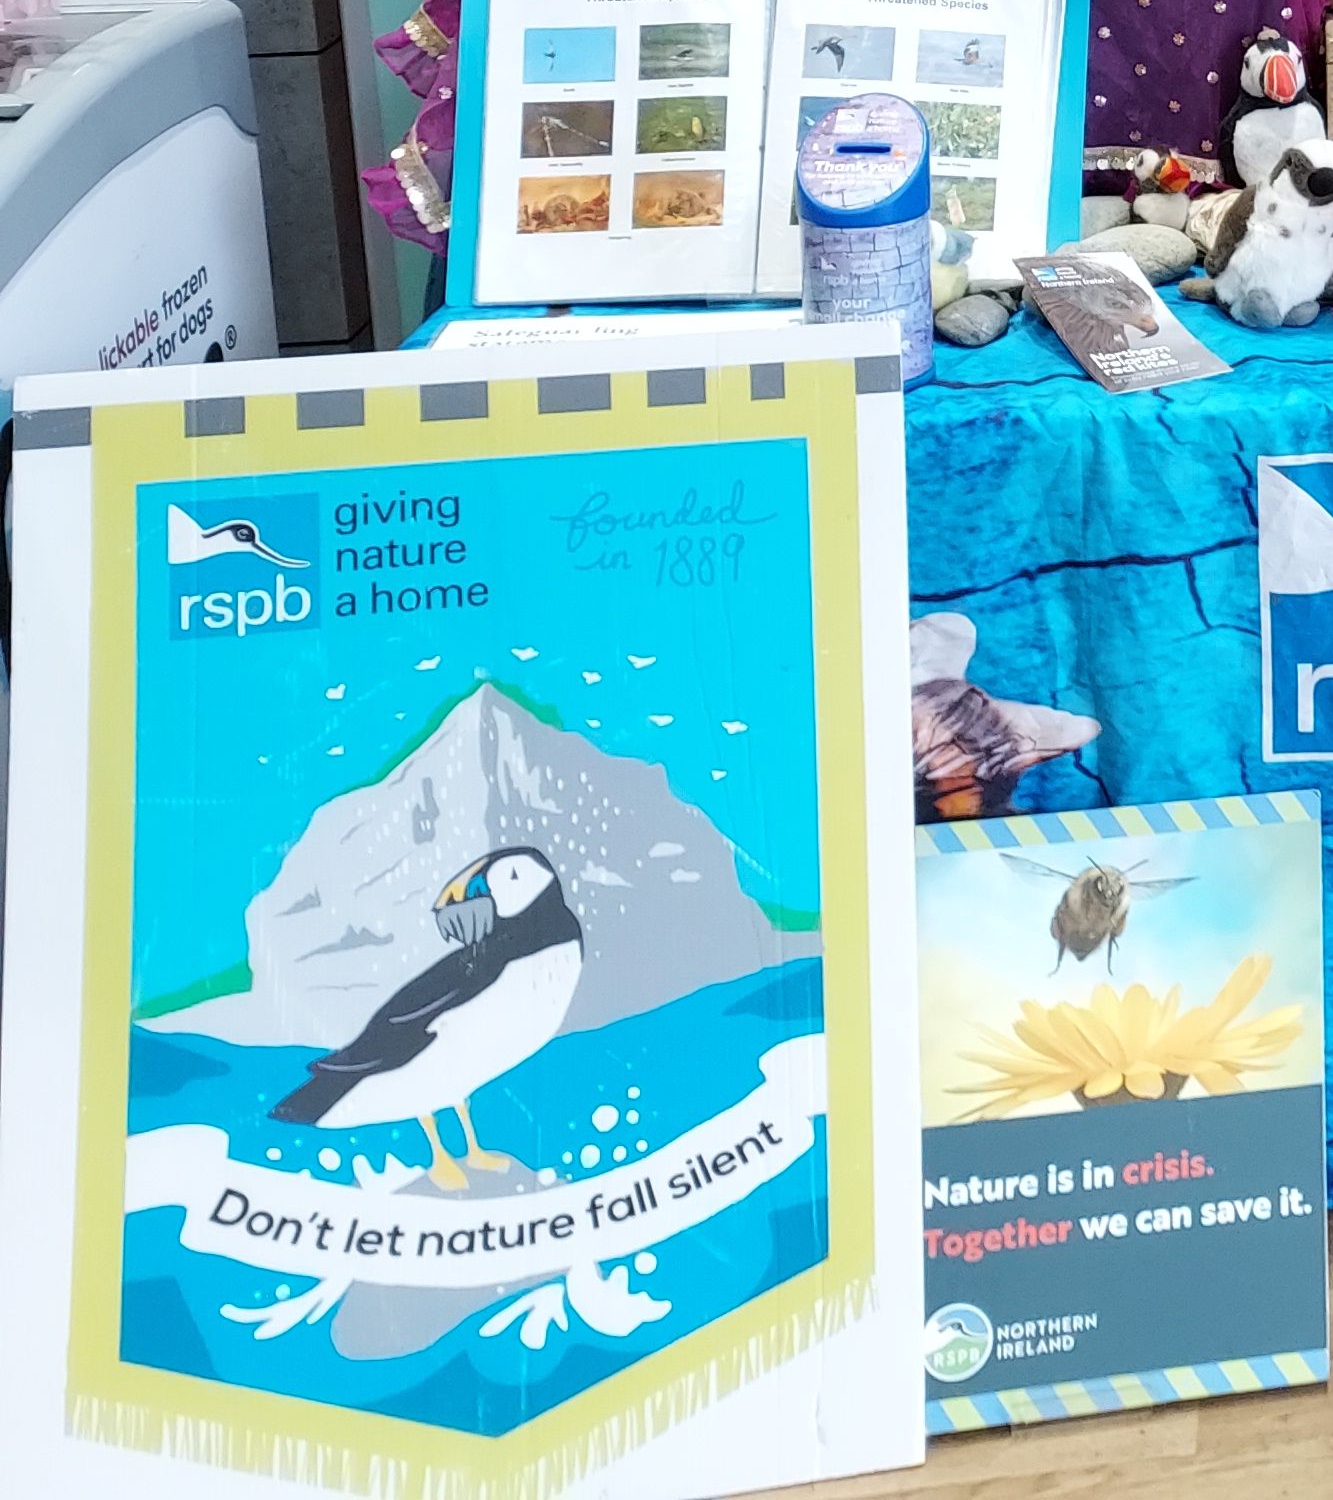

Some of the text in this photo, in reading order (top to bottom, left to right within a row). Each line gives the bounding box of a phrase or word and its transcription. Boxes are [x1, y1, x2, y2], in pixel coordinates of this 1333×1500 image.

[814, 160, 899, 175] Thank you
[162, 265, 208, 320] frozen
[1040, 277, 1115, 289] Northern Ireland
[832, 298, 871, 313] your
[156, 330, 177, 365] for
[179, 298, 213, 345] dogs
[1089, 345, 1171, 364] Northern
[335, 490, 461, 536] giving
[549, 480, 778, 552] founded
[336, 537, 468, 572] nature
[653, 536, 746, 589] 1889
[178, 574, 312, 637] rspb
[335, 578, 490, 618] a home
[208, 1117, 785, 1258] Don't let nature fall silent
[924, 1149, 1215, 1210] Nature is in crisis.
[923, 1186, 1312, 1263] Together we can save it.
[996, 1312, 1098, 1341] NORTHERN
[996, 1334, 1075, 1360] IRELAND
[932, 1347, 980, 1369] RSPB
